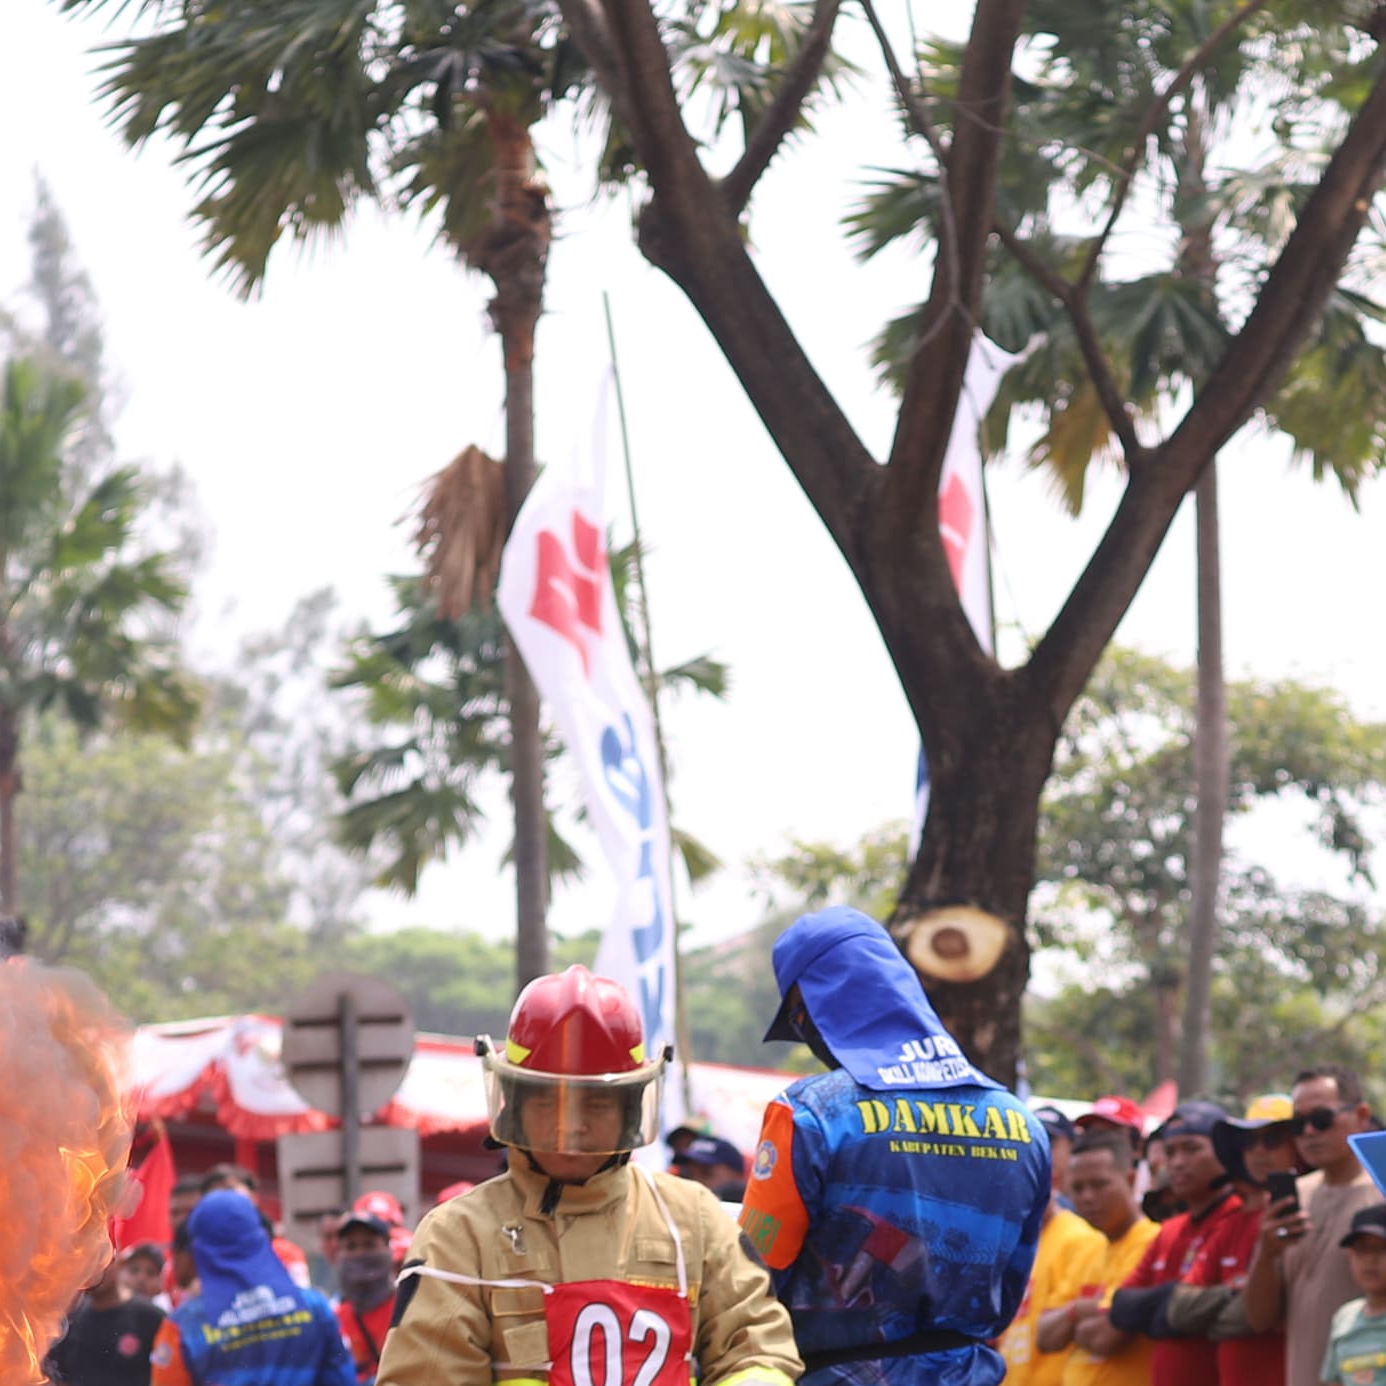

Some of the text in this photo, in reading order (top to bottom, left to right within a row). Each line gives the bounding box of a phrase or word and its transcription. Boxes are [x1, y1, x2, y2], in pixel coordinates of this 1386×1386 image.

[856, 1099, 1032, 1144] DAMKAR
[889, 1140, 1018, 1162] KABUPATEN BEKASI
